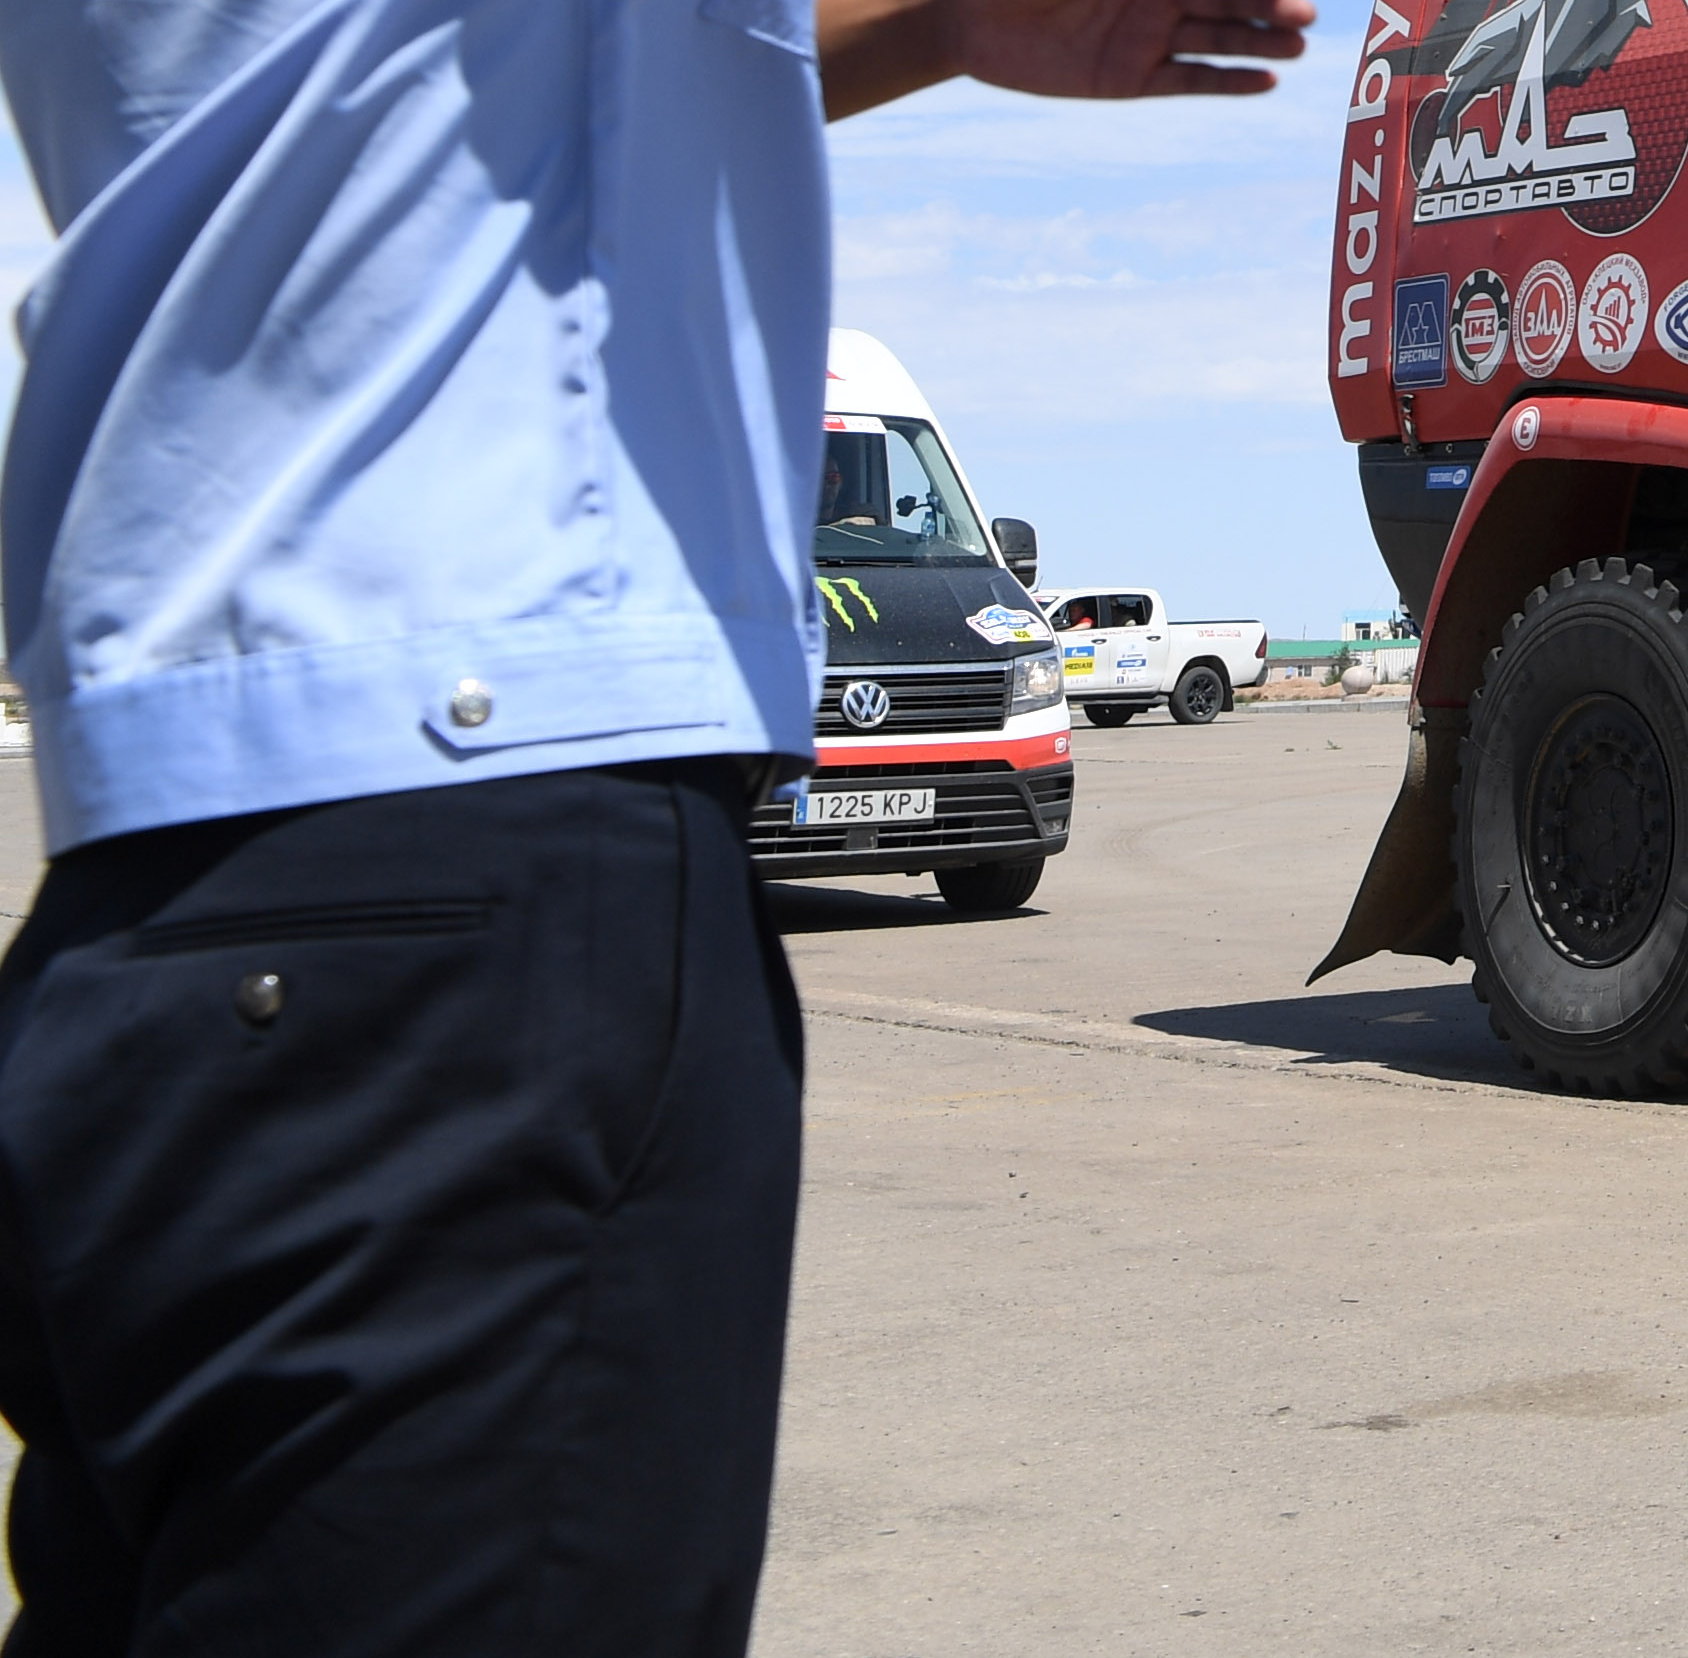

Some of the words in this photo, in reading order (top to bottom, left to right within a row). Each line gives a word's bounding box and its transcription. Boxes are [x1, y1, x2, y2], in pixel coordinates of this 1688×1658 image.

[1418, 170, 1633, 219] СПОРТАВТО
[1399, 345, 1441, 364] БРЕСТМАШ
[817, 794, 874, 820] 1225
[883, 792, 927, 816] KPJ
